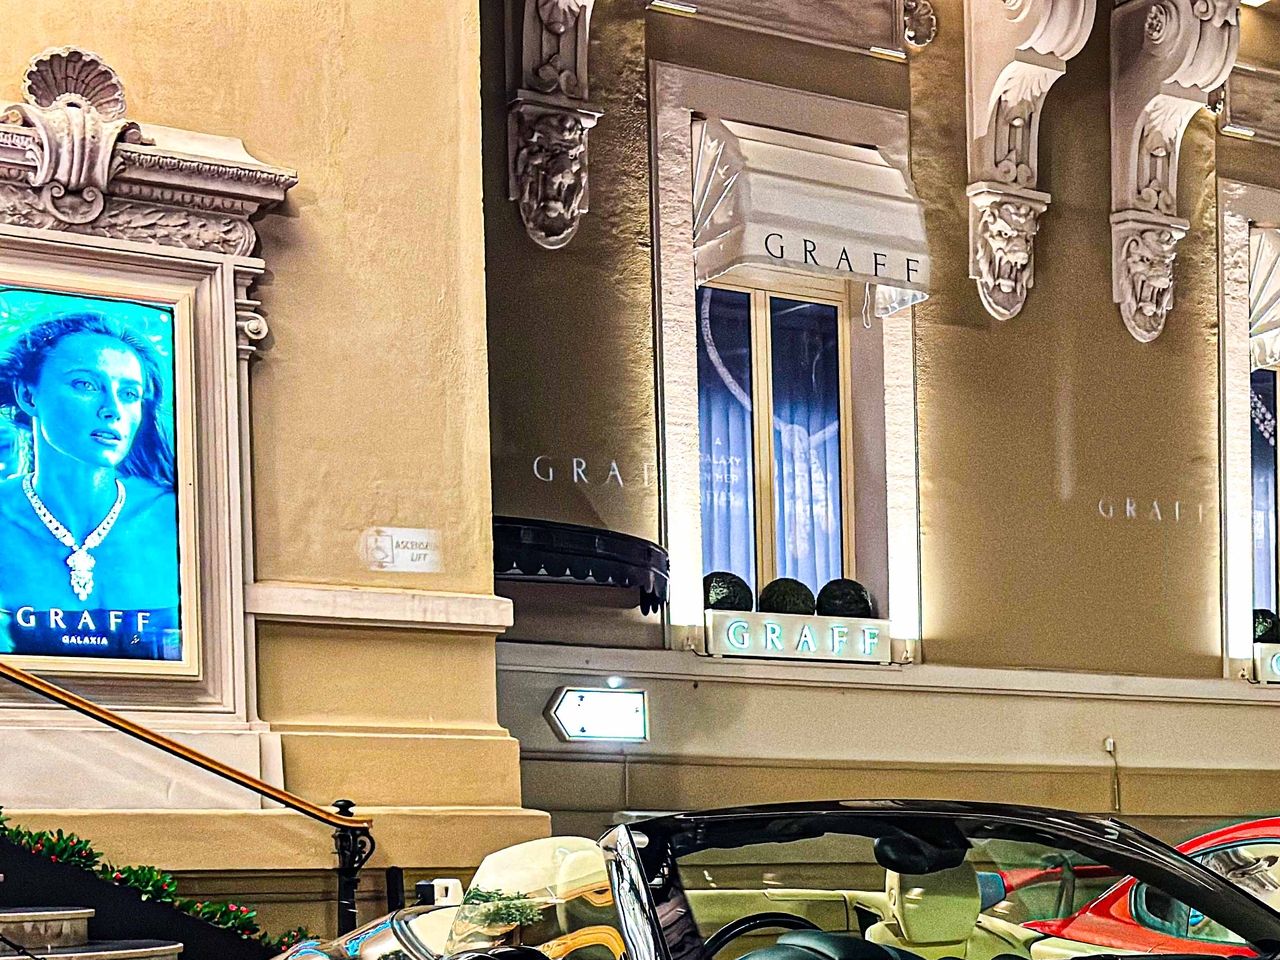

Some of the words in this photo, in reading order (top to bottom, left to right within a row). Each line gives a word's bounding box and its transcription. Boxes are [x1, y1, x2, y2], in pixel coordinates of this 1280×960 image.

[764, 233, 919, 283] GRAFF
[533, 454, 655, 487] GRAF
[16, 606, 150, 632] GRAFF
[61, 635, 109, 646] GALAXIA
[727, 620, 880, 656] GRAFF
